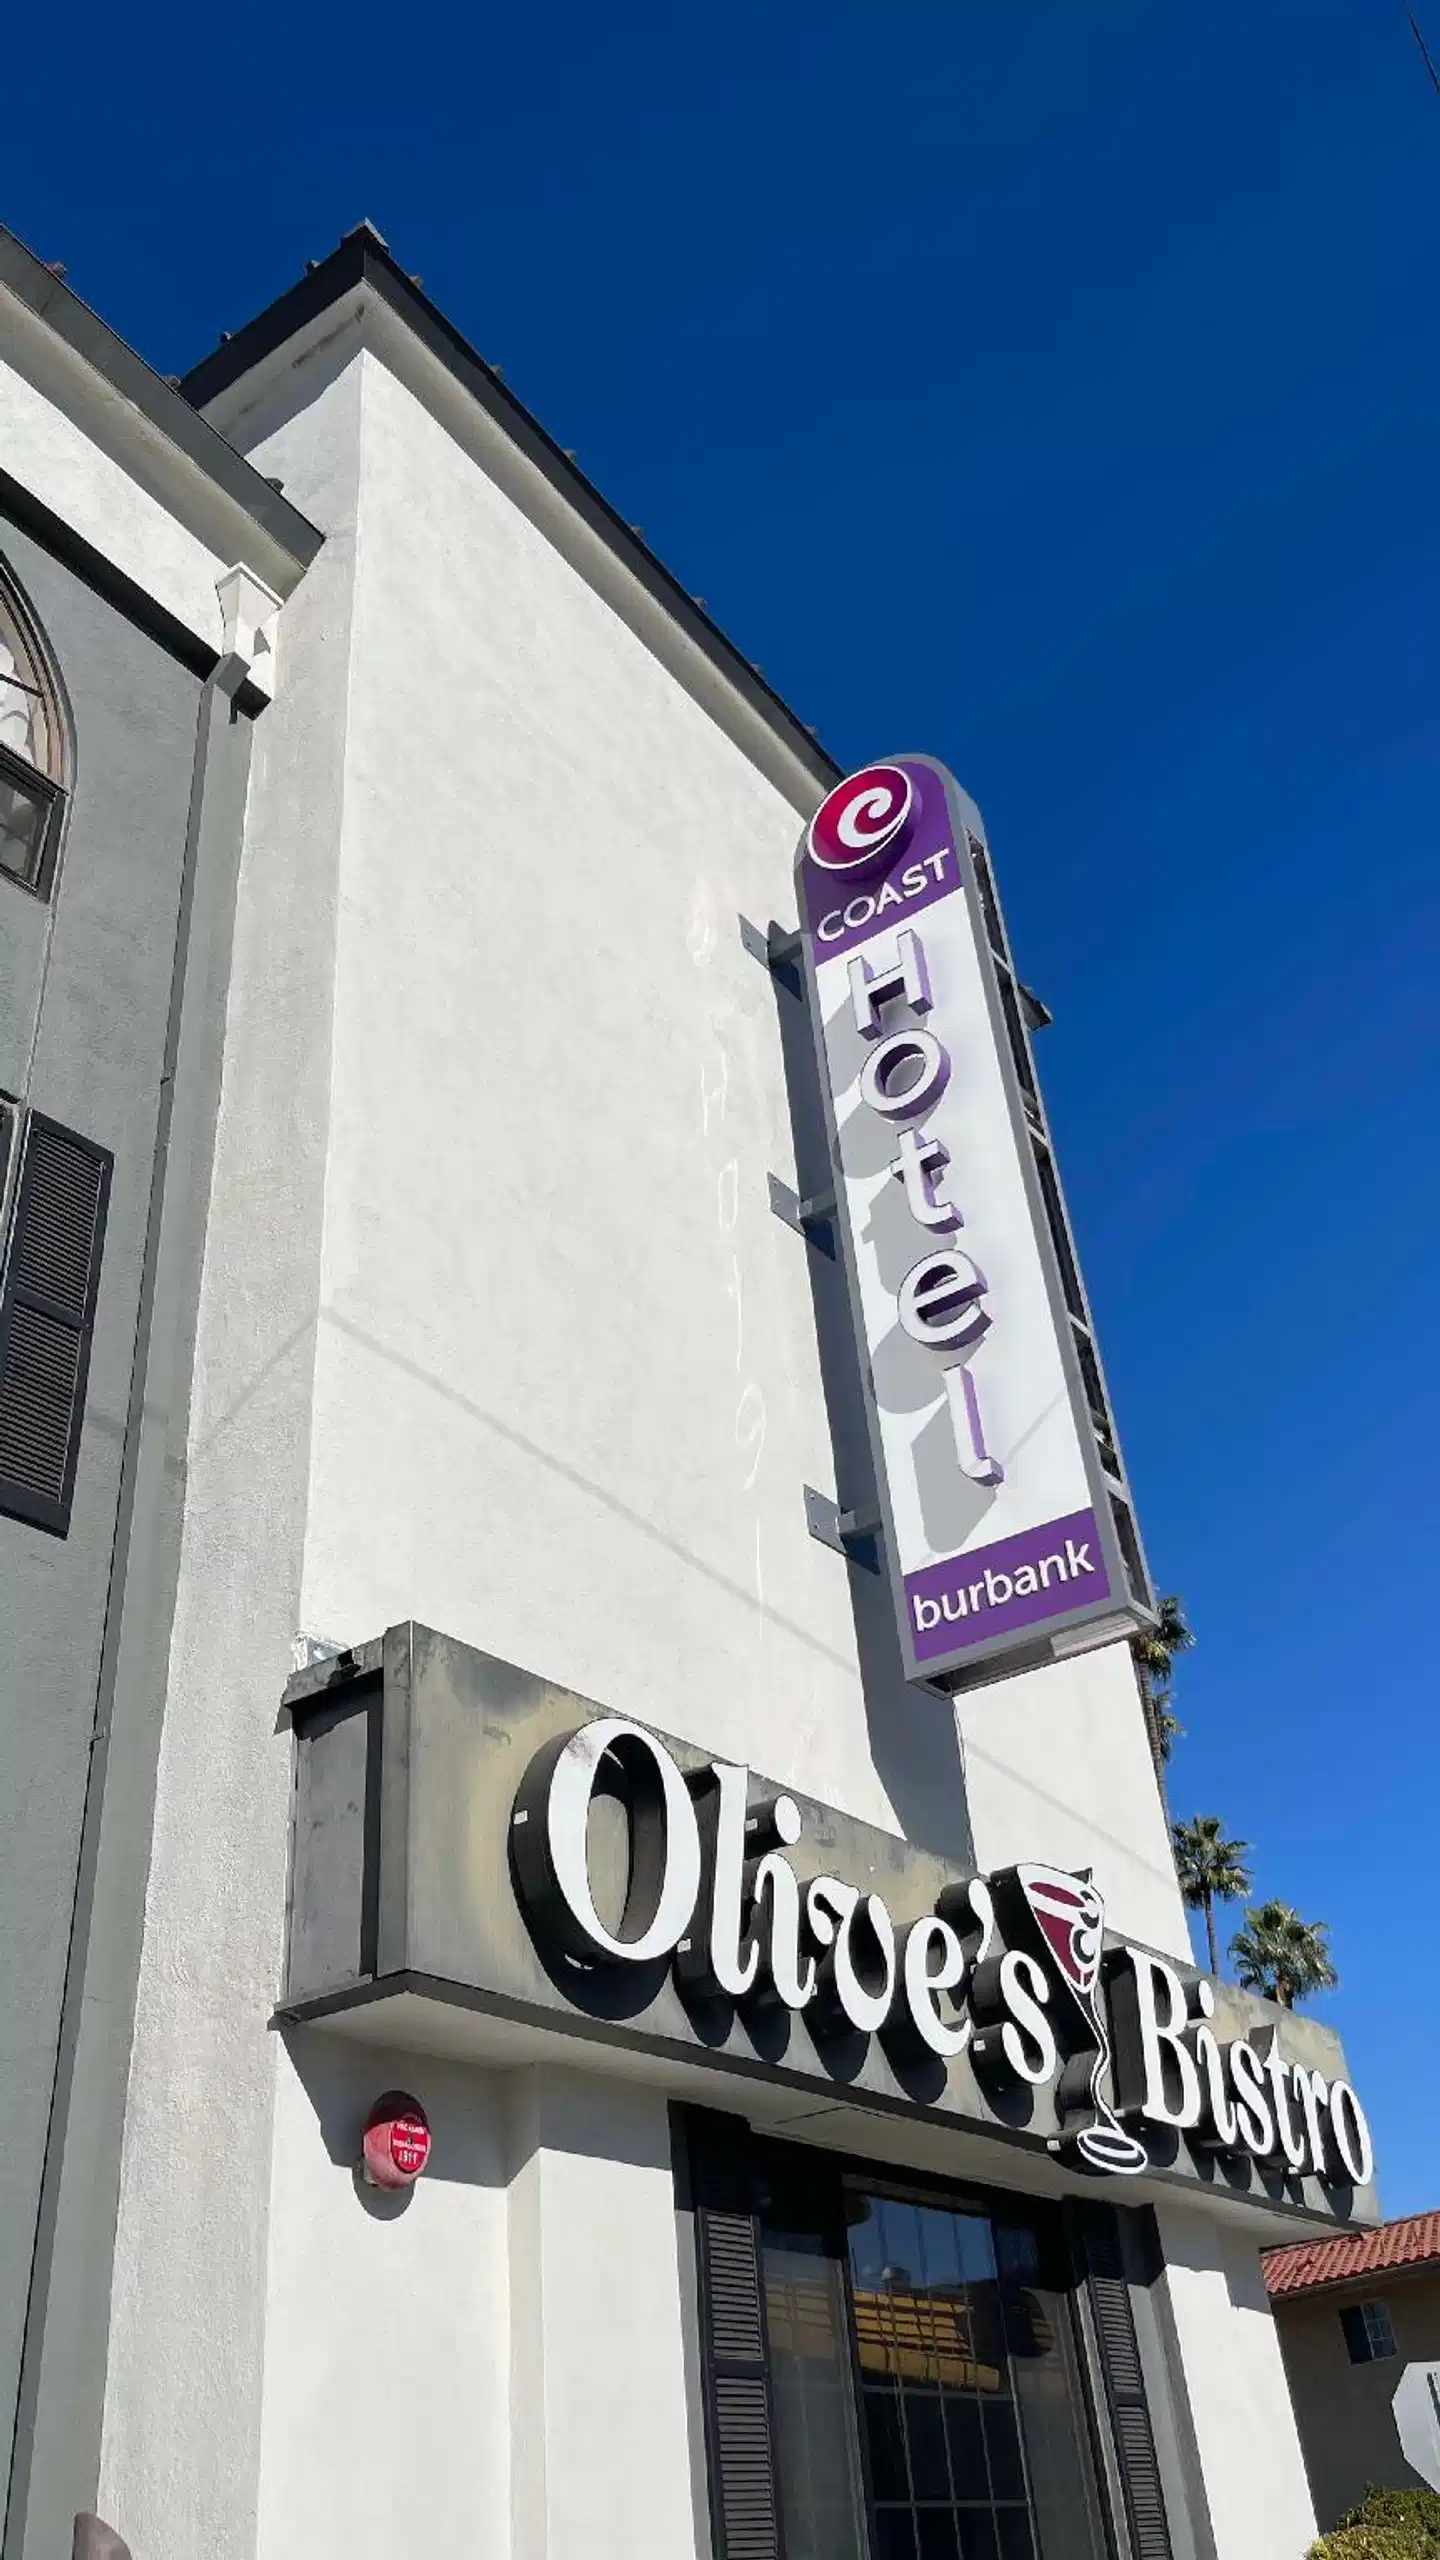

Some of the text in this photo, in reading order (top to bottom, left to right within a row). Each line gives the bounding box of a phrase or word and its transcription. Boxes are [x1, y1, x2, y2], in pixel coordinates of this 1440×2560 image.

[817, 848, 950, 942] COAST
[847, 929, 1003, 1487] Hotel
[912, 1539, 1095, 1632] burbank
[546, 1716, 1373, 2187] Olive's Bistro
